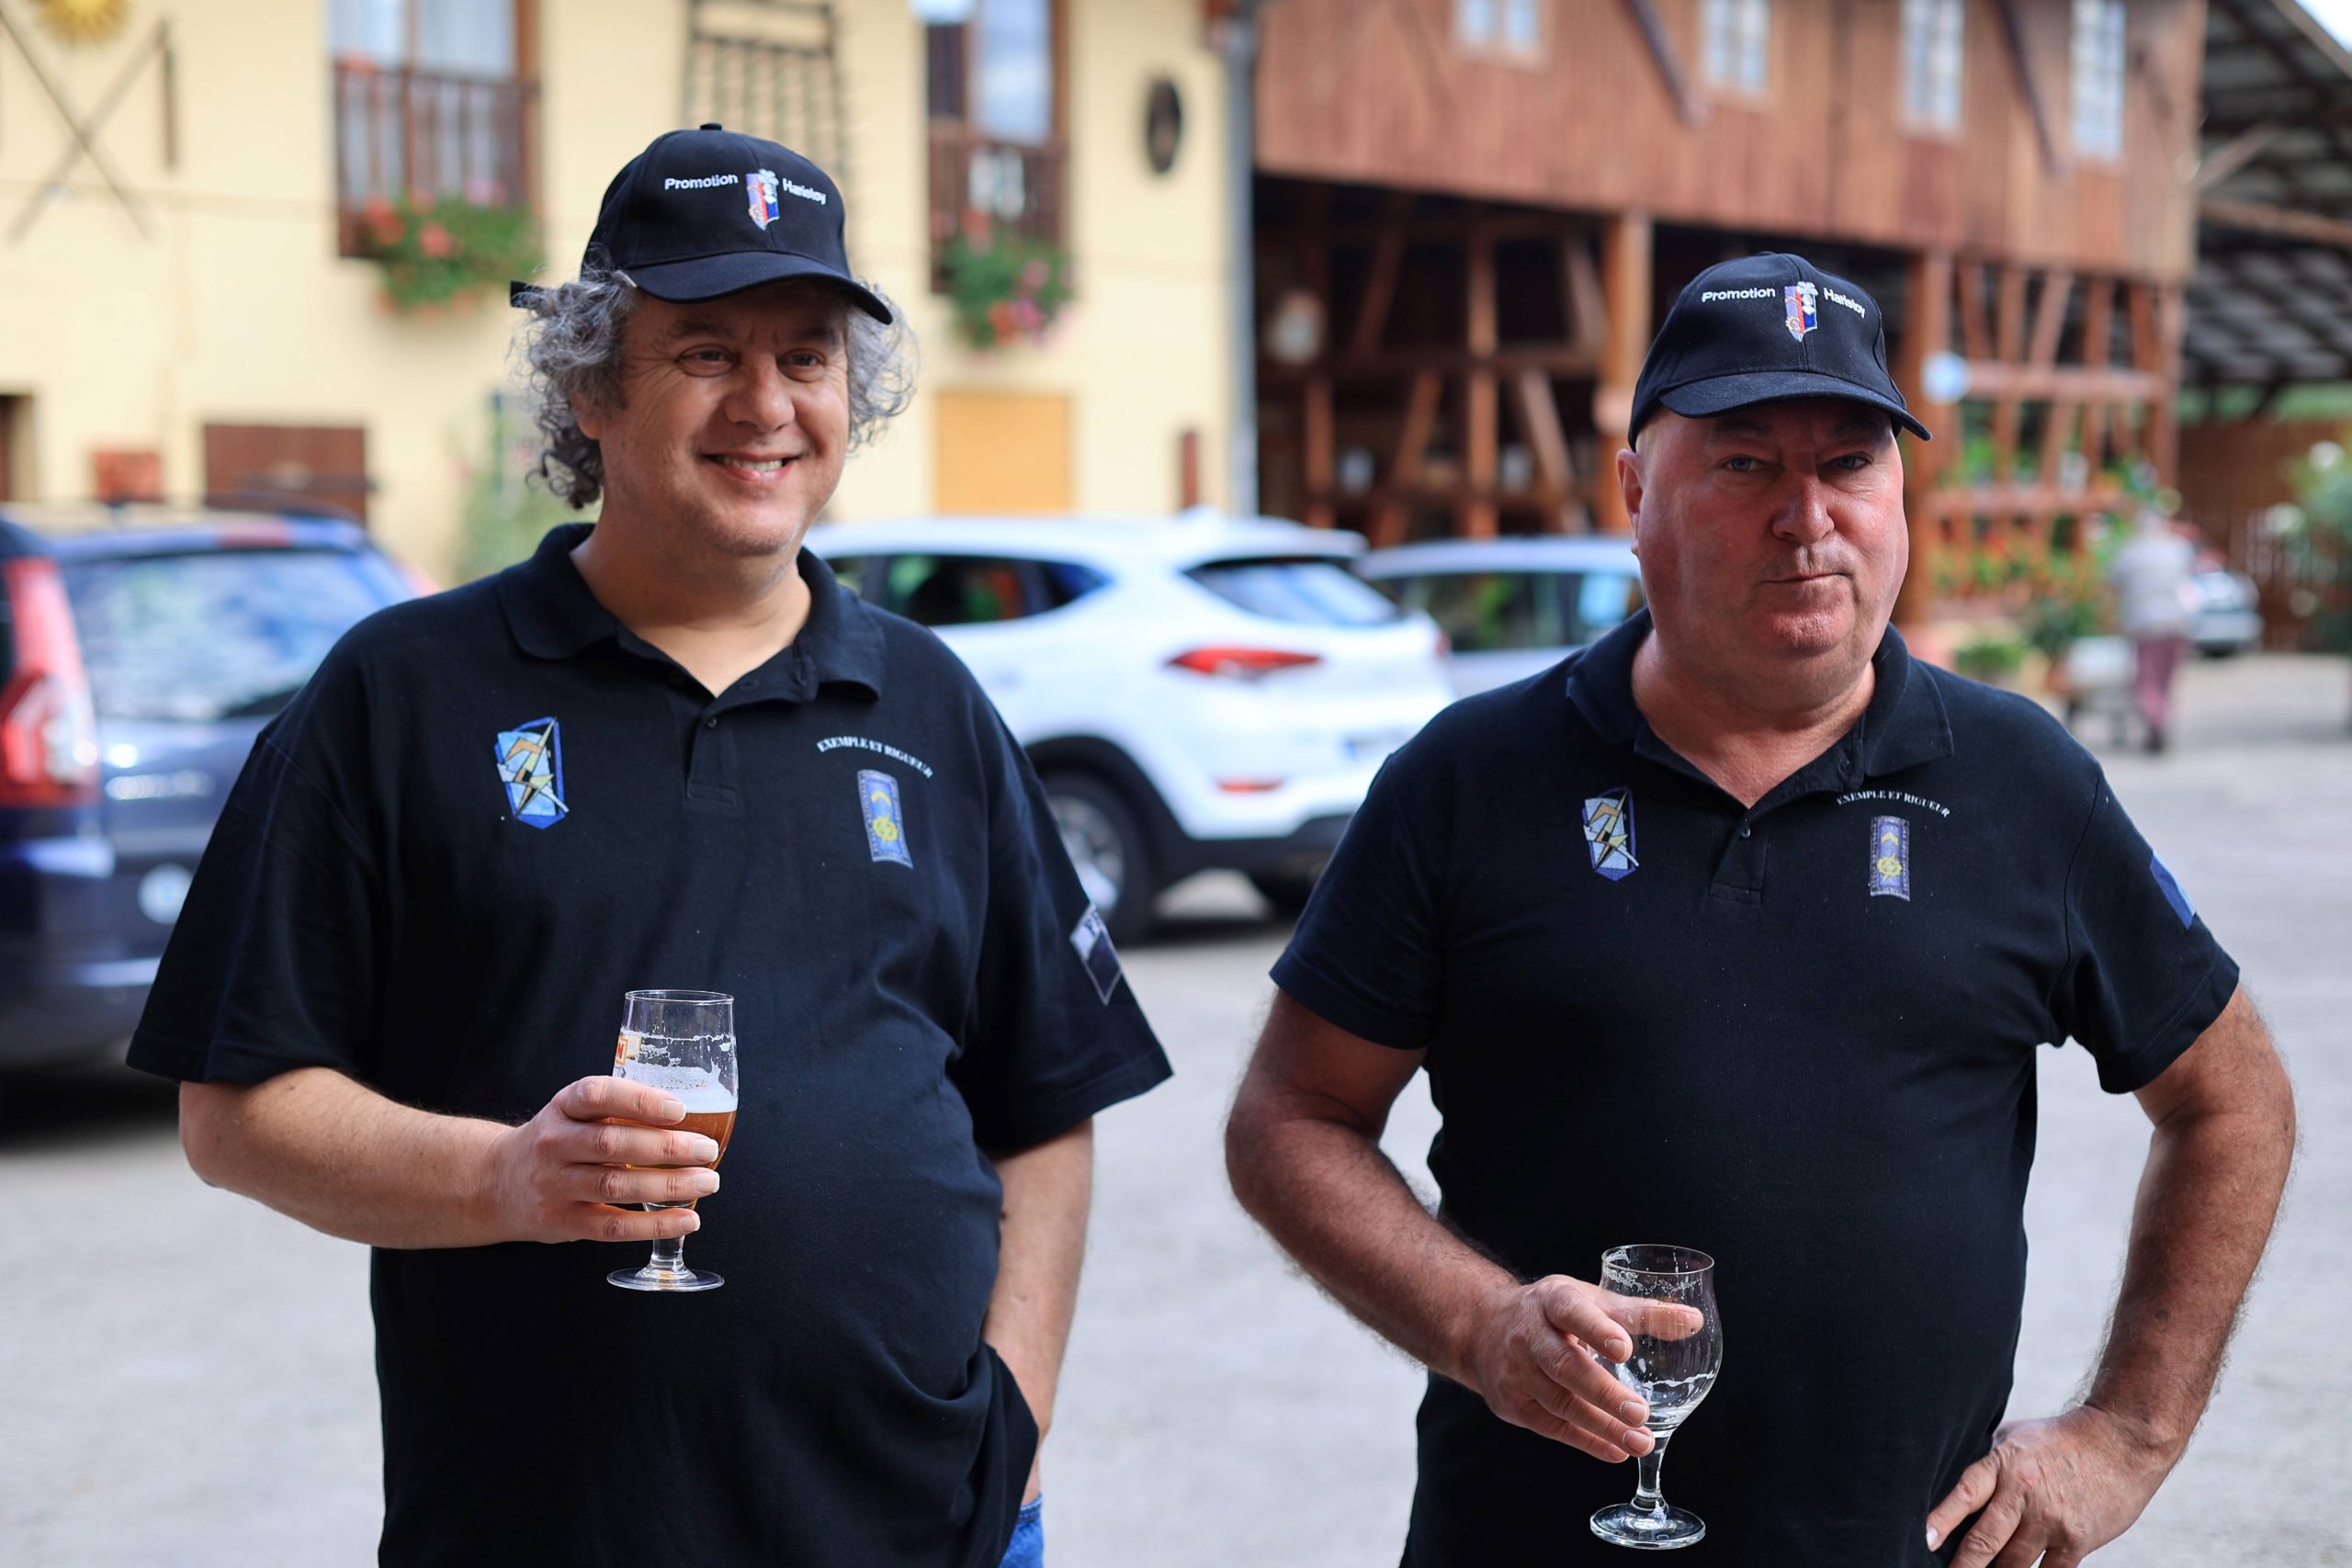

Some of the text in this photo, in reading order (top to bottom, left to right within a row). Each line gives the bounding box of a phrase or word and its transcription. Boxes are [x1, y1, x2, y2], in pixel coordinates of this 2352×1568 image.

[664, 173, 739, 191] Promotion
[1702, 287, 1776, 303] Promotion
[816, 735, 934, 779] EXEMPLE ET RIGUEUR
[1837, 789, 1951, 818] EXEMPLE ET RIGUEUR
